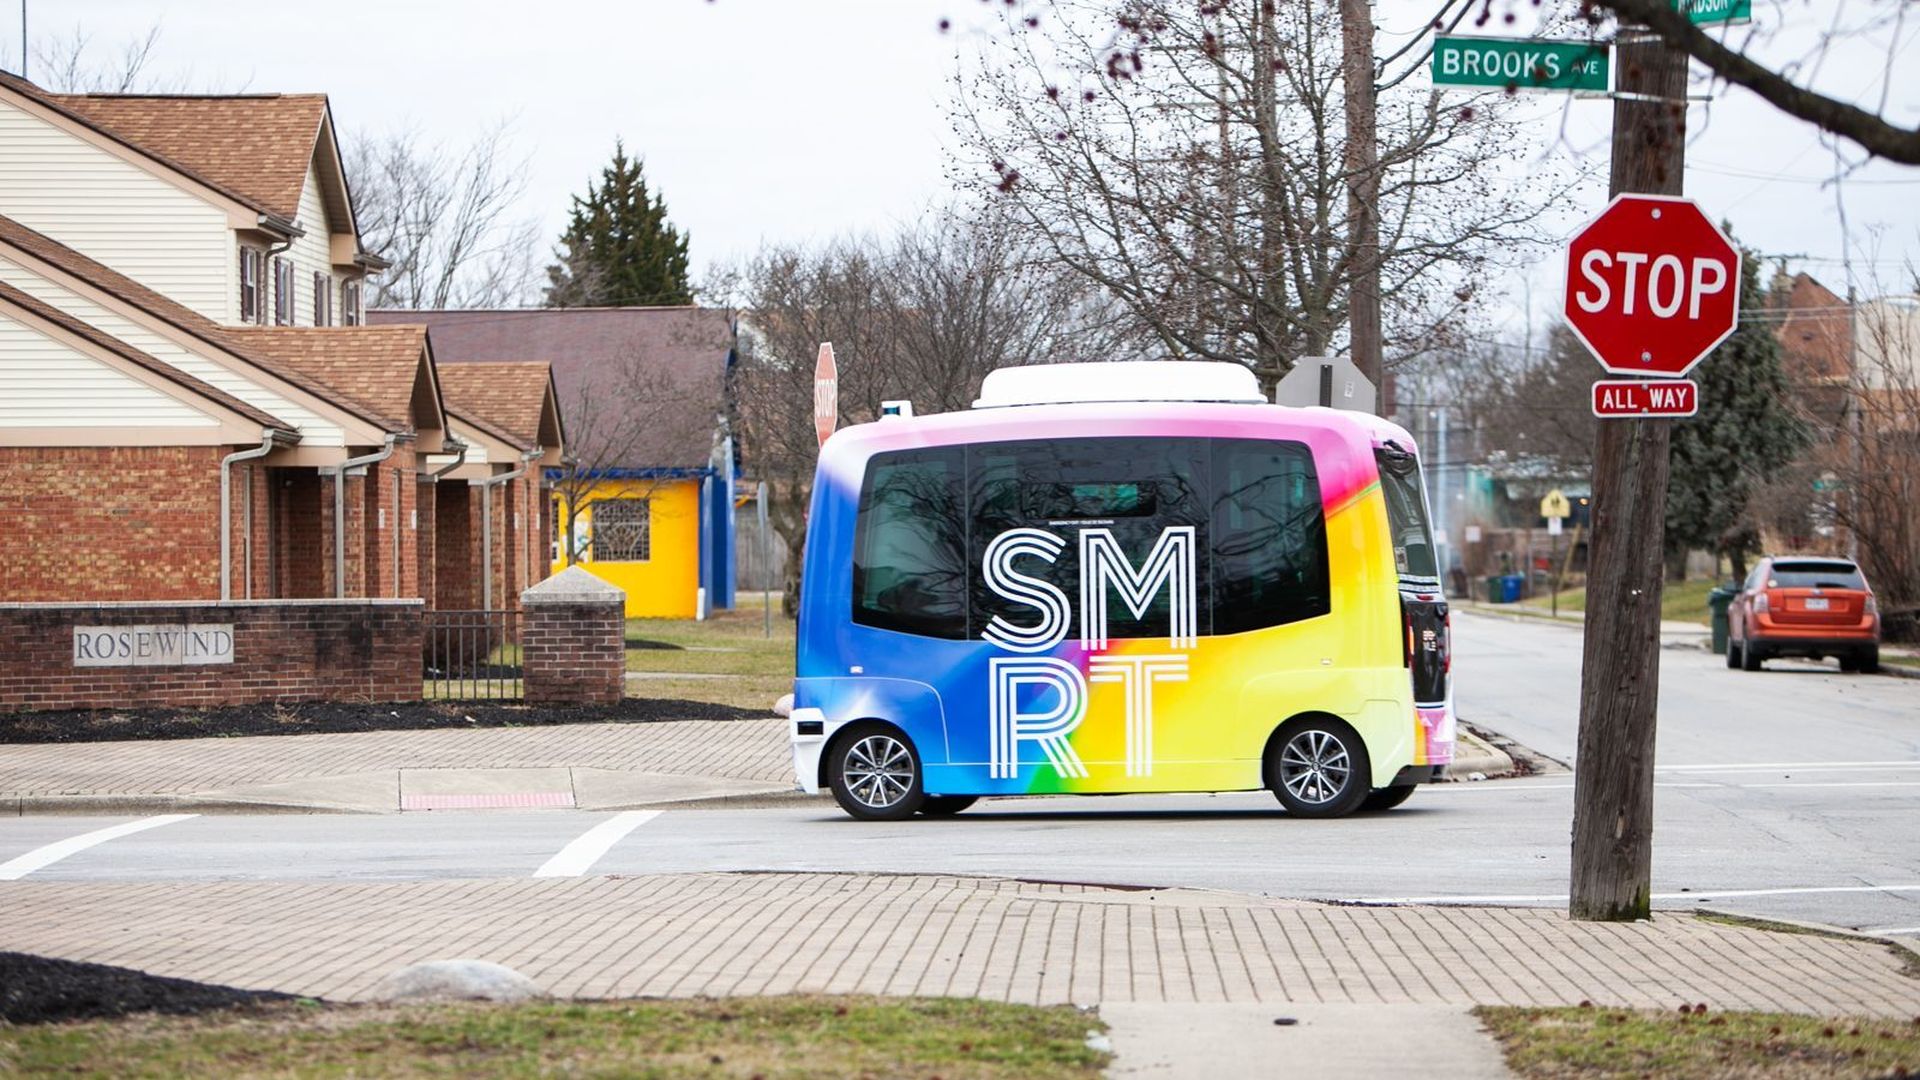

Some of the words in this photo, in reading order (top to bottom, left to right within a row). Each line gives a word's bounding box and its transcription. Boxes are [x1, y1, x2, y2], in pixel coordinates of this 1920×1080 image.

[1443, 48, 1560, 79] BROOKS
[1571, 61, 1599, 75] AVE
[1576, 249, 1727, 320] STOP
[815, 379, 837, 417] STOP
[1602, 388, 1638, 409] ALL
[1649, 387, 1687, 408] WAY
[980, 526, 1197, 653] SM
[77, 630, 232, 659] ROSEWIND
[989, 654, 1189, 779] RT
